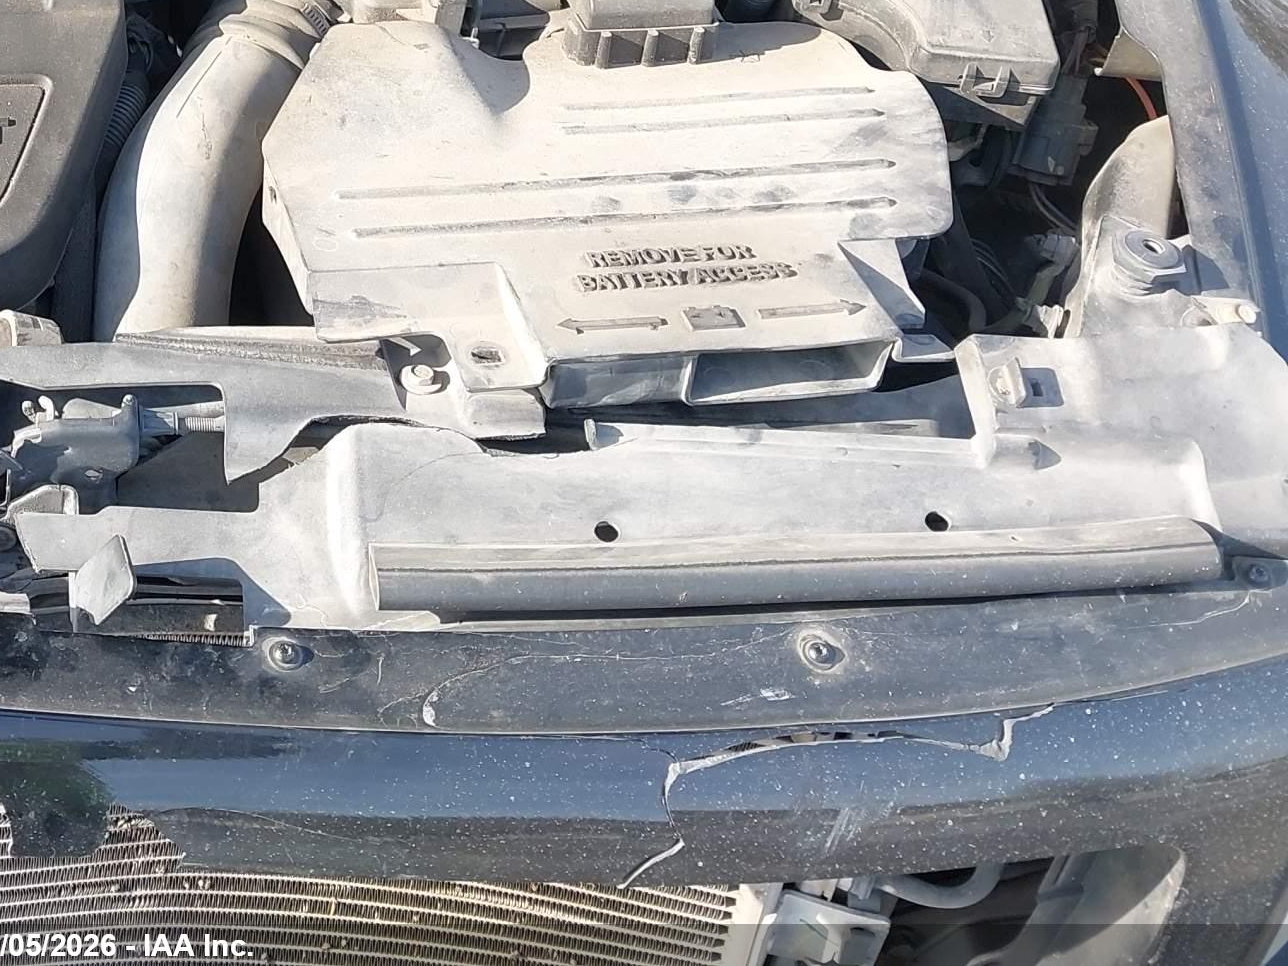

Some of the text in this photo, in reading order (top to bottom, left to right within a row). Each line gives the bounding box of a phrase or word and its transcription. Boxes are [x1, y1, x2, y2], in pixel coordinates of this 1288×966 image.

[585, 243, 758, 268] REMOVE FOR
[576, 261, 799, 293] BATTERY ACCESS
